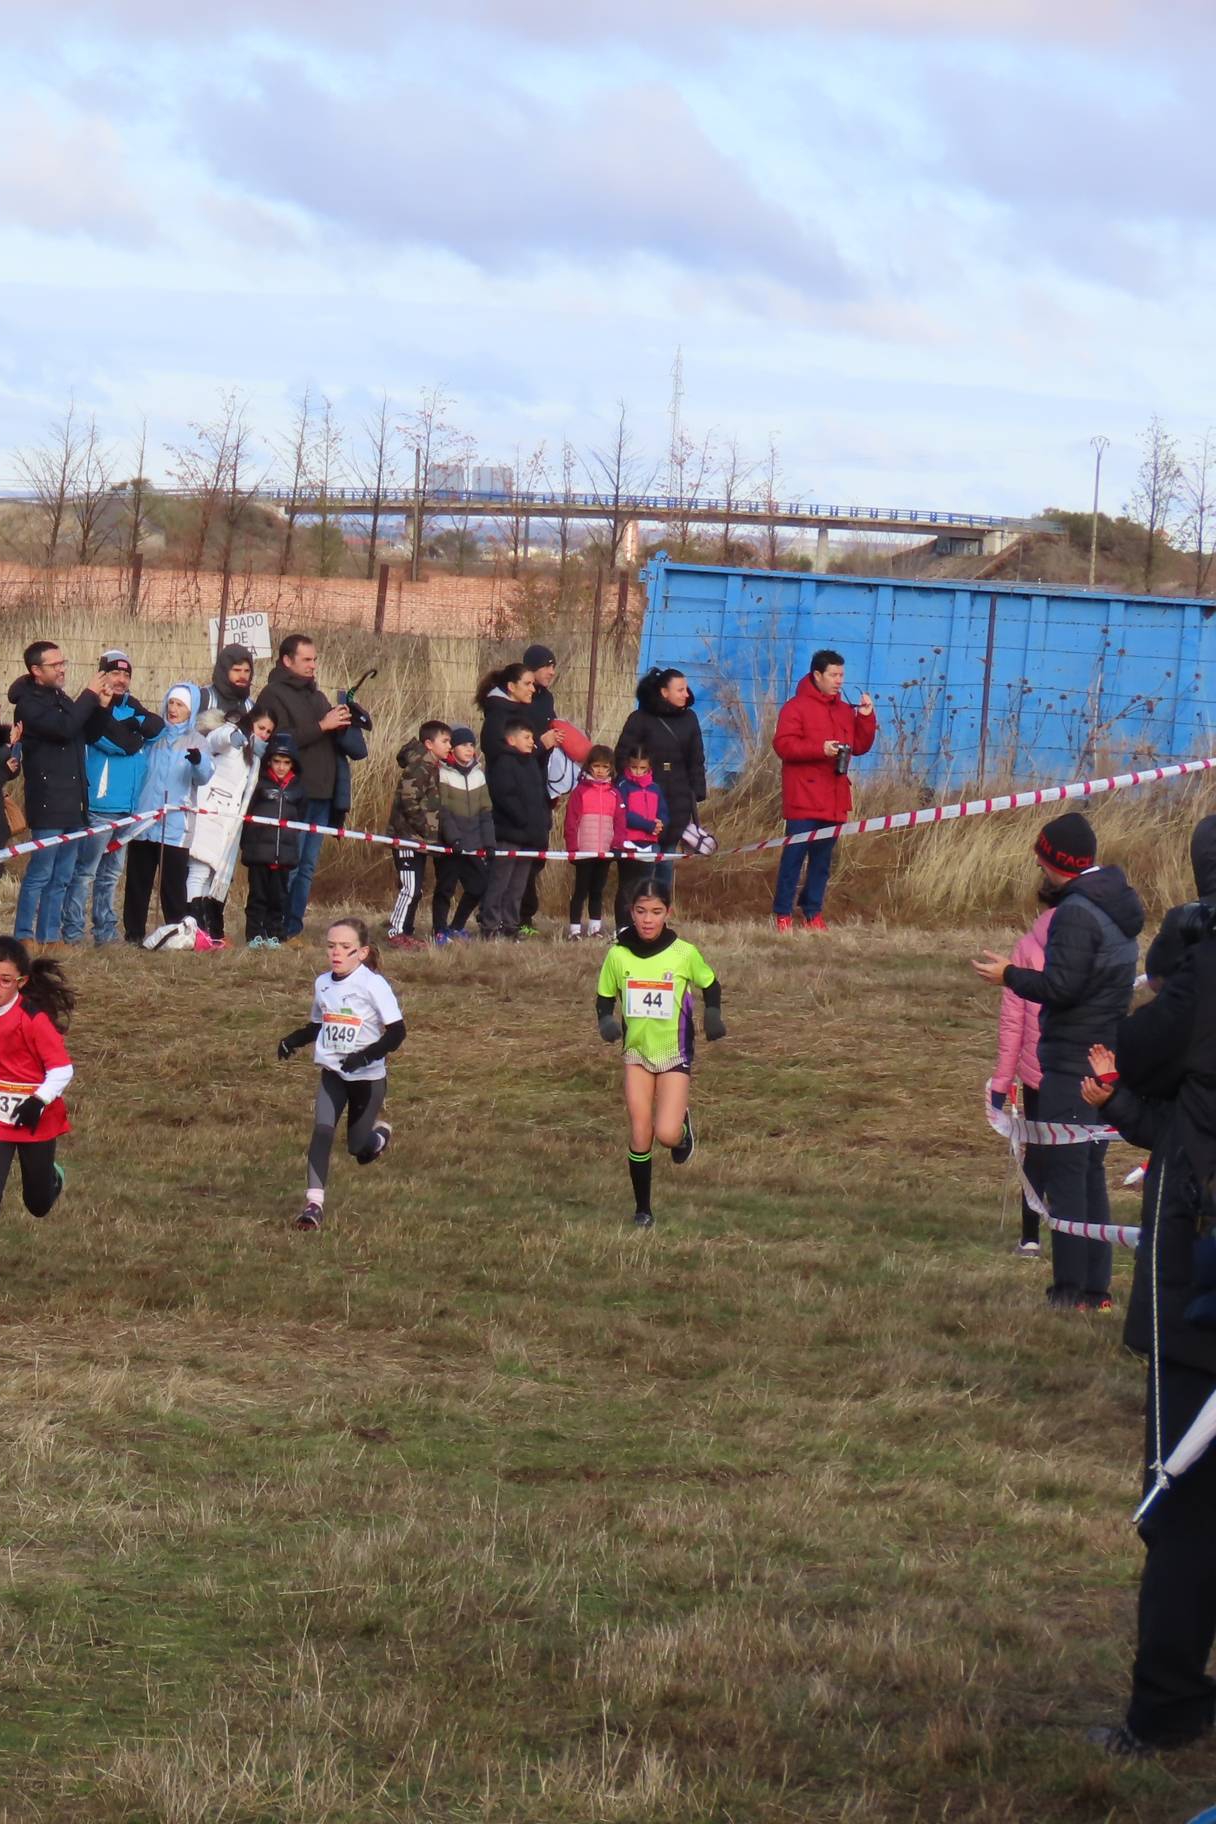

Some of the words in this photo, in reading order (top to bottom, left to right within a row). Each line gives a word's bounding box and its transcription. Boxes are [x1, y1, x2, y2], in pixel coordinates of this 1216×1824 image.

[232, 631, 249, 644] DE
[642, 991, 663, 1008] 44
[325, 1024, 356, 1043] 1249
[0, 1095, 23, 1113] 37
